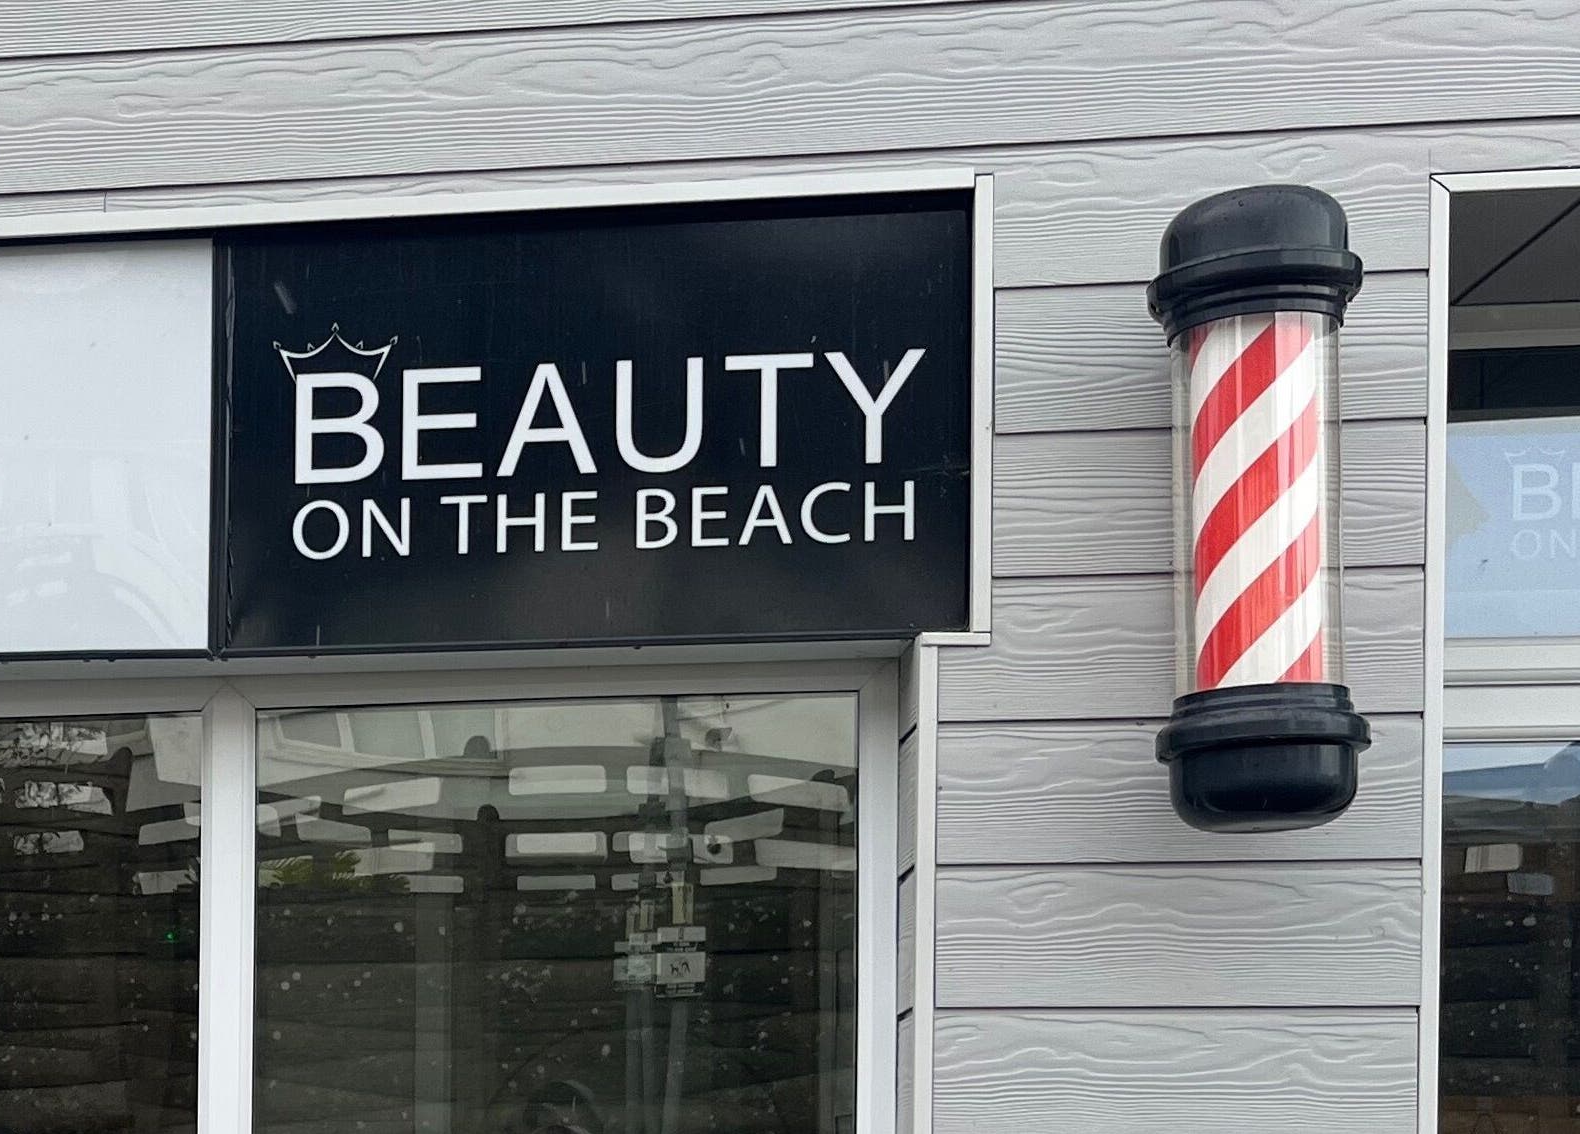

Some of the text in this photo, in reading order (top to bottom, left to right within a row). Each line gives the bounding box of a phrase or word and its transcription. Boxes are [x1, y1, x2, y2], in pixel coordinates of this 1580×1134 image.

[294, 347, 927, 486] BEAUTY
[292, 479, 915, 561] ON THE BEACH
[1511, 462, 1580, 522] B
[1510, 528, 1577, 560] ON
